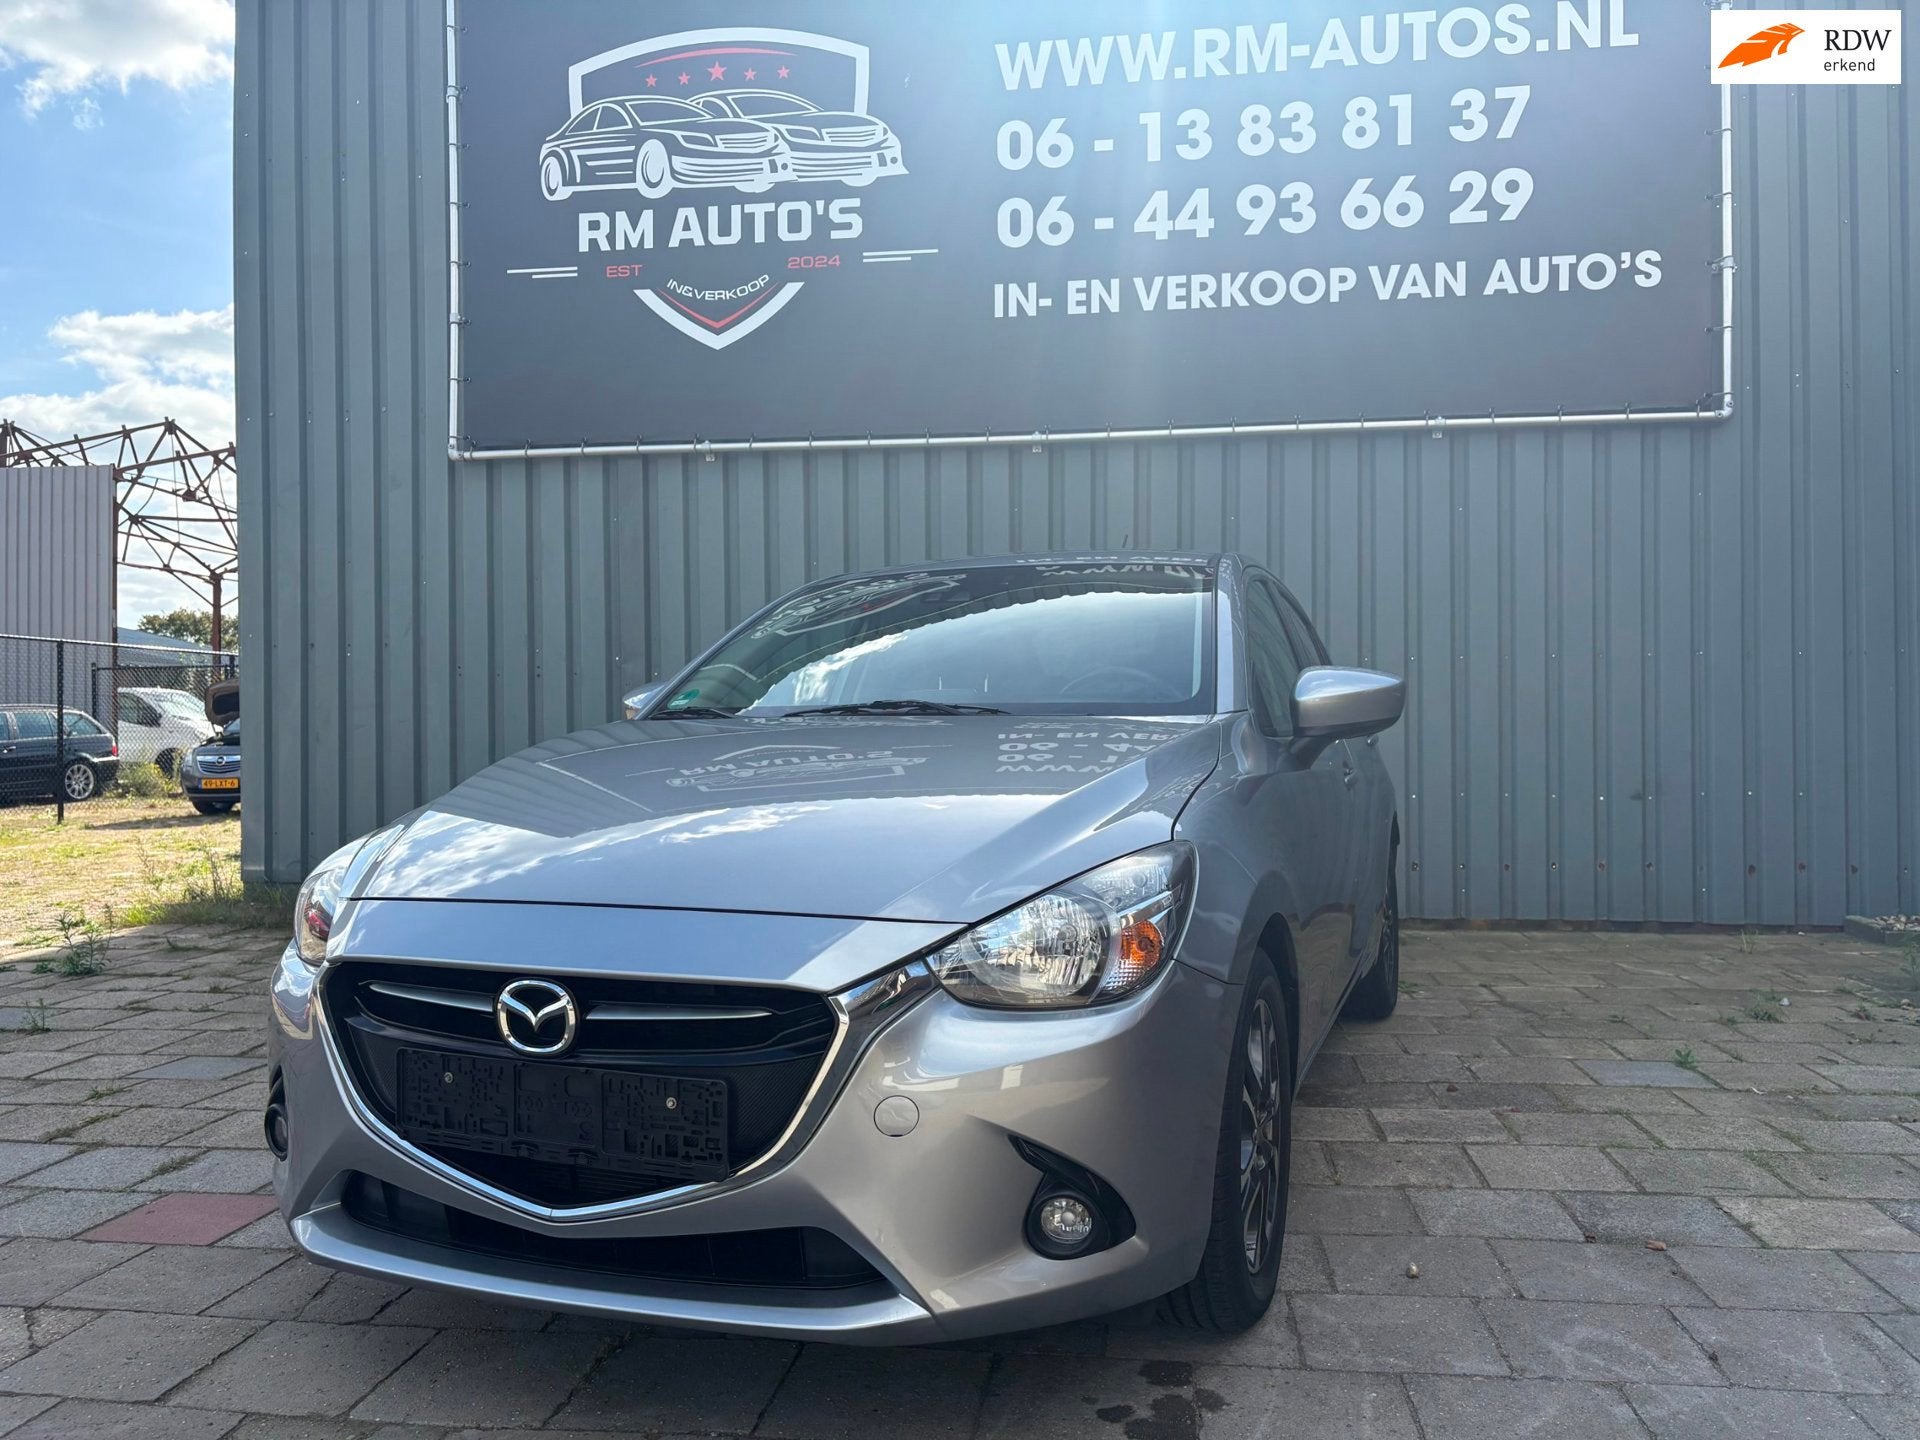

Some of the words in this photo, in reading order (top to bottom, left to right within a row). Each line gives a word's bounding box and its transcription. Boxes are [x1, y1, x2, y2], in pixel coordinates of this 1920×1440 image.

[994, 0, 1639, 91] WWW.RM-AUTOS.NL
[996, 117, 1075, 171] 06
[1139, 108, 1213, 162] 13
[1237, 101, 1317, 157] 83
[1341, 93, 1412, 150] 81
[1448, 85, 1531, 142] 37
[578, 208, 654, 253] RM
[668, 197, 863, 249] AUTO'S
[997, 195, 1075, 248] 06
[1133, 187, 1215, 241] 44
[1236, 181, 1317, 236] 93
[1340, 175, 1425, 231] 66
[1449, 167, 1534, 224] 29
[606, 264, 643, 278] EST
[787, 255, 841, 269] 2024
[994, 282, 1052, 318] IN-
[1067, 278, 1120, 315] EN
[1133, 267, 1357, 311] VERKOOP
[1368, 260, 1467, 300] VAN
[1482, 250, 1662, 295] AUTO’S
